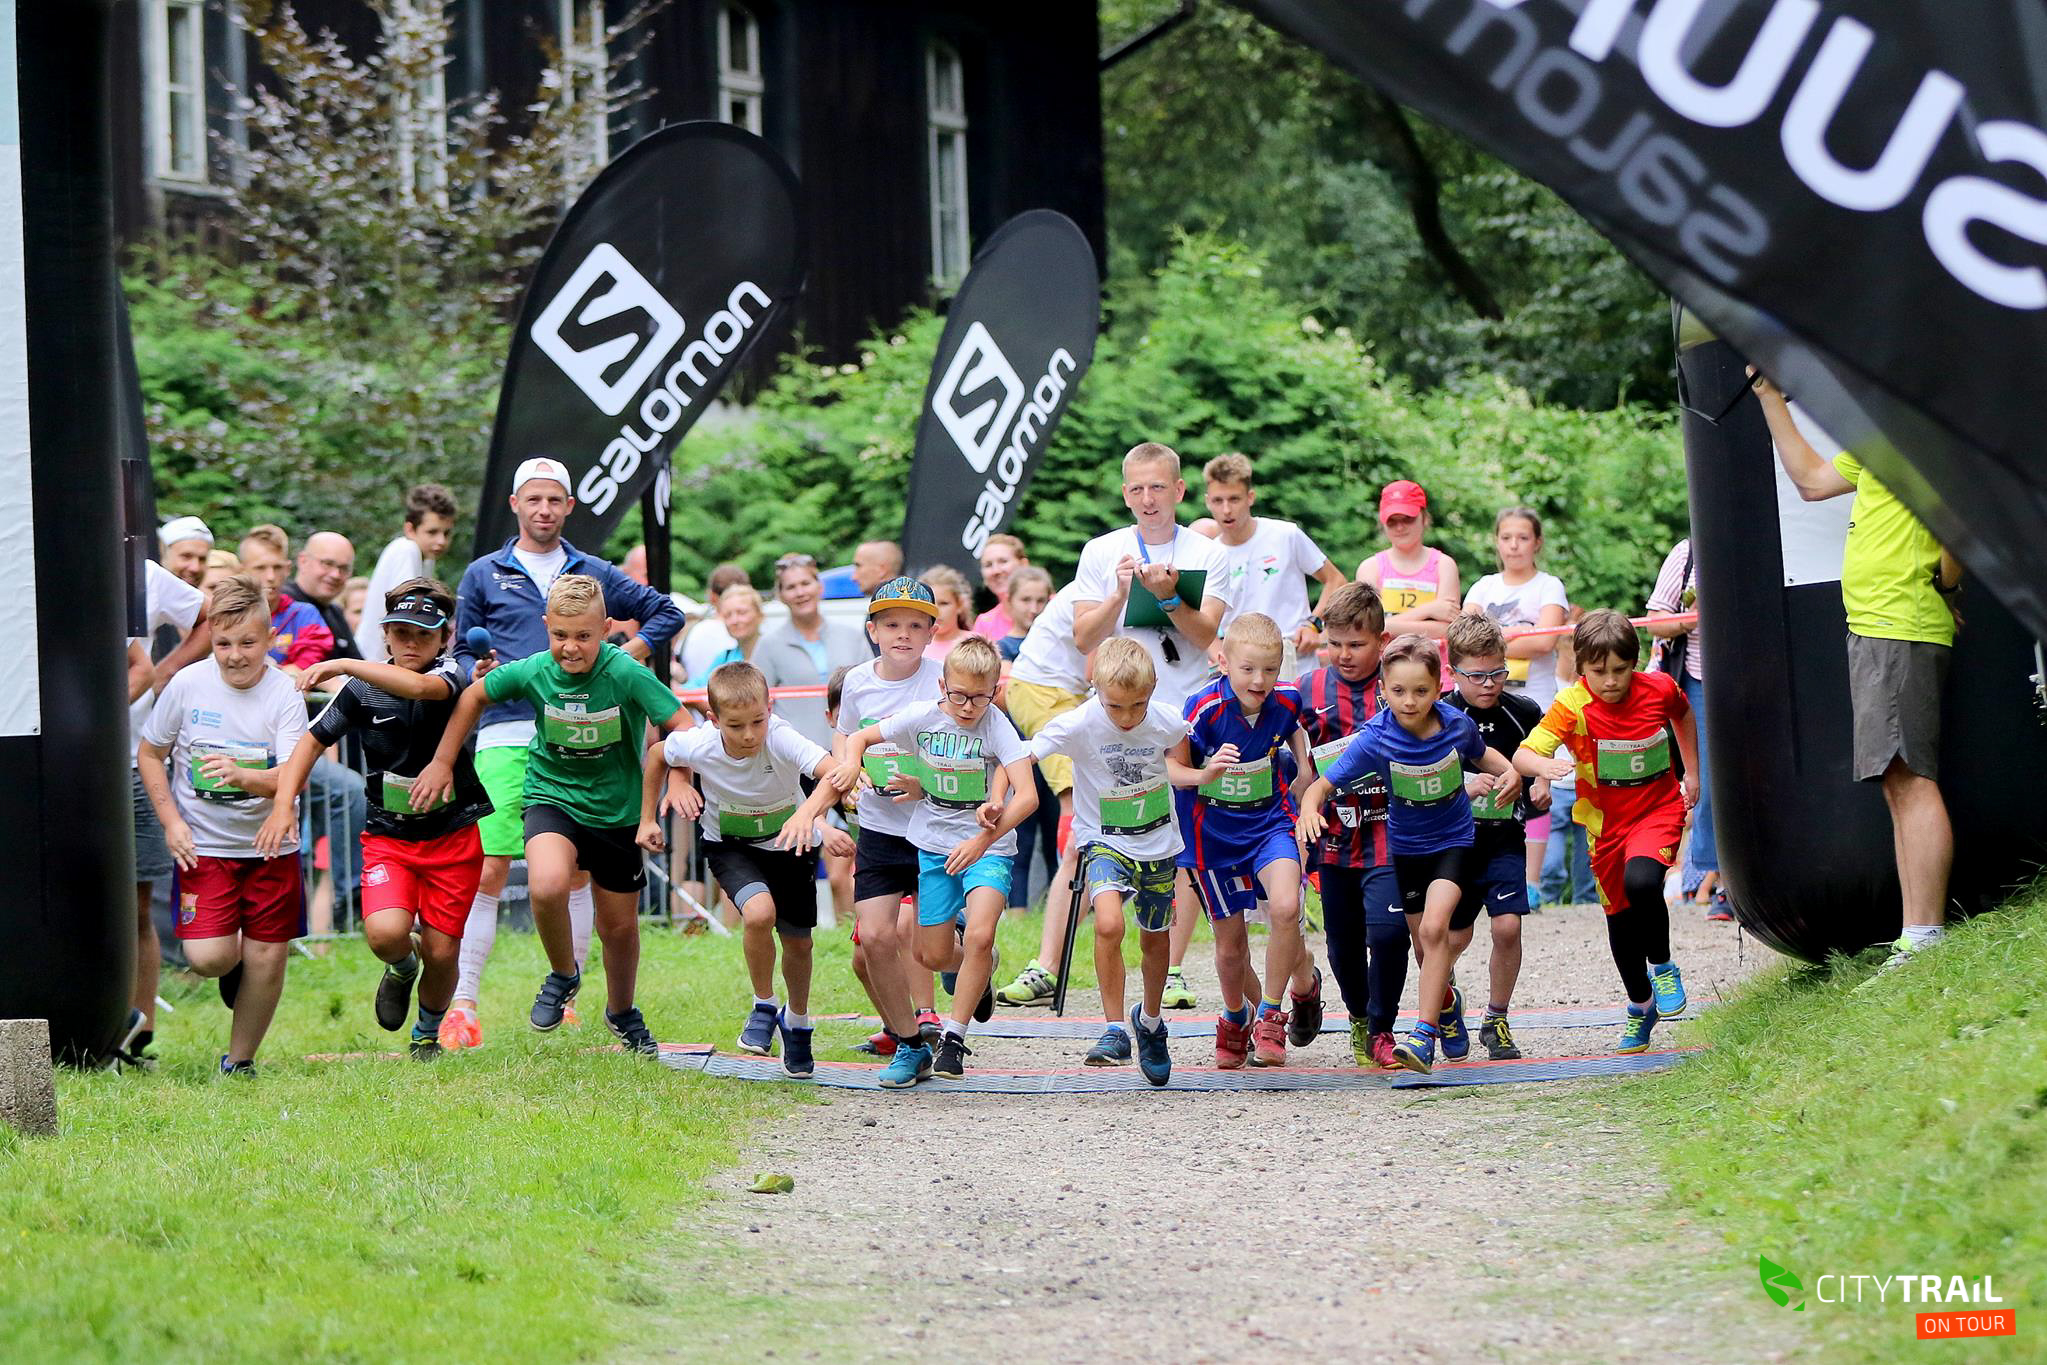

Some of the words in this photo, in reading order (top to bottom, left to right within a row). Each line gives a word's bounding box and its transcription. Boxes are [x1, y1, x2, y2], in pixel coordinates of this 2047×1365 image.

[577, 281, 772, 516] salomon
[962, 348, 1077, 560] salomon
[1400, 593, 1417, 608] 12
[192, 709, 199, 724] 3
[566, 726, 599, 743] 20
[917, 731, 983, 759] CHILL
[1100, 744, 1123, 754] HERE
[1124, 747, 1155, 757] COMES
[884, 760, 899, 785] 3
[1630, 755, 1645, 774] 6
[934, 773, 958, 795] 10
[1221, 777, 1251, 796] 55
[1416, 777, 1441, 796] 18
[1132, 798, 1146, 820] 7
[754, 818, 764, 833] 1
